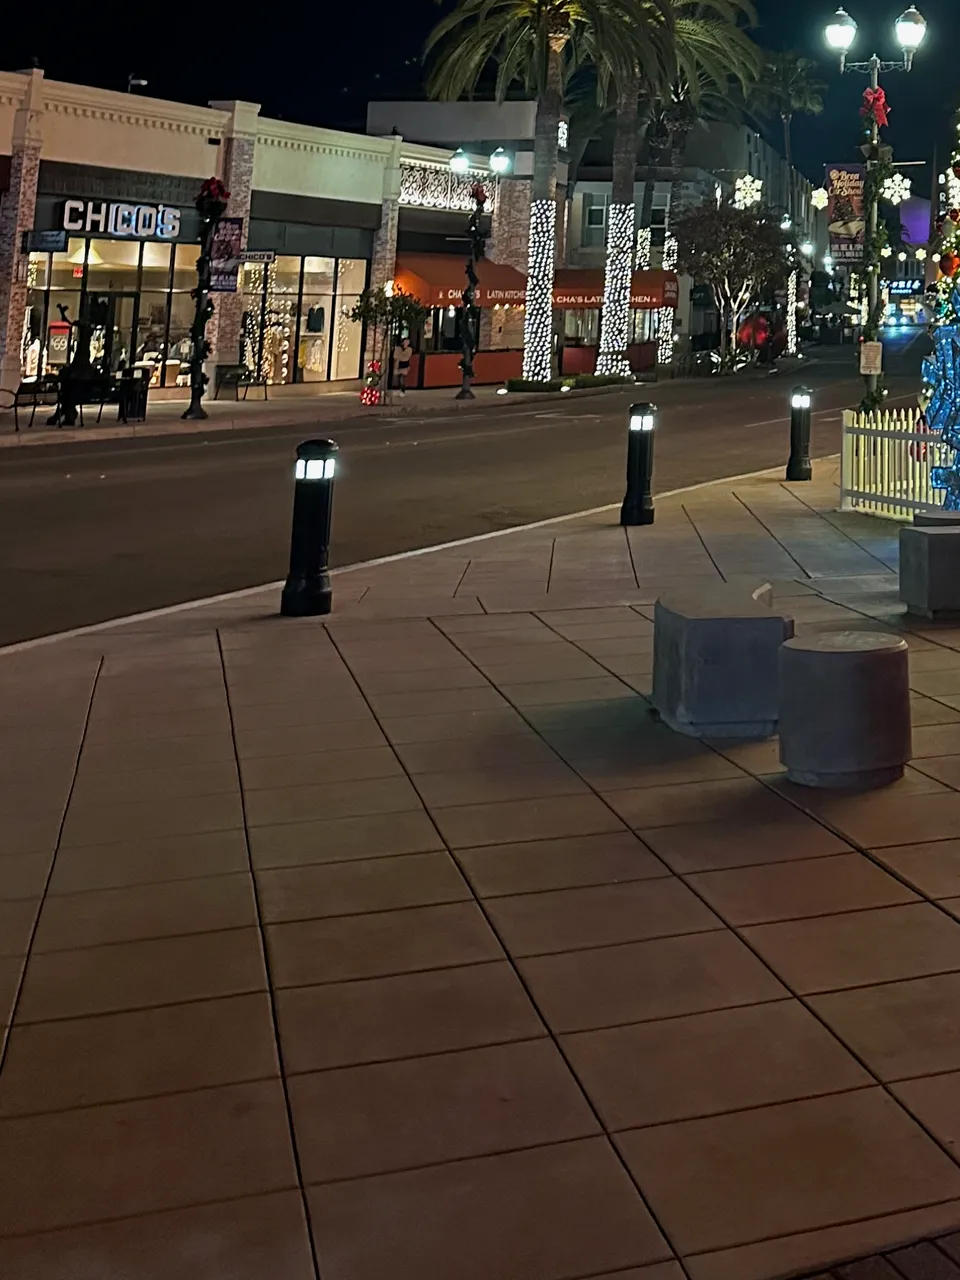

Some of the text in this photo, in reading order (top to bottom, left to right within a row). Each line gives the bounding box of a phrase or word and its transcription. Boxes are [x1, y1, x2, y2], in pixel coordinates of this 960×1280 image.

[839, 170, 860, 181] Brea
[63, 200, 181, 237] CHICO'S
[240, 251, 273, 261] CHICO'S
[487, 289, 504, 299] LATIN
[505, 290, 526, 299] KITCHE
[556, 295, 583, 303] CHA'S
[584, 295, 604, 303] LATI
